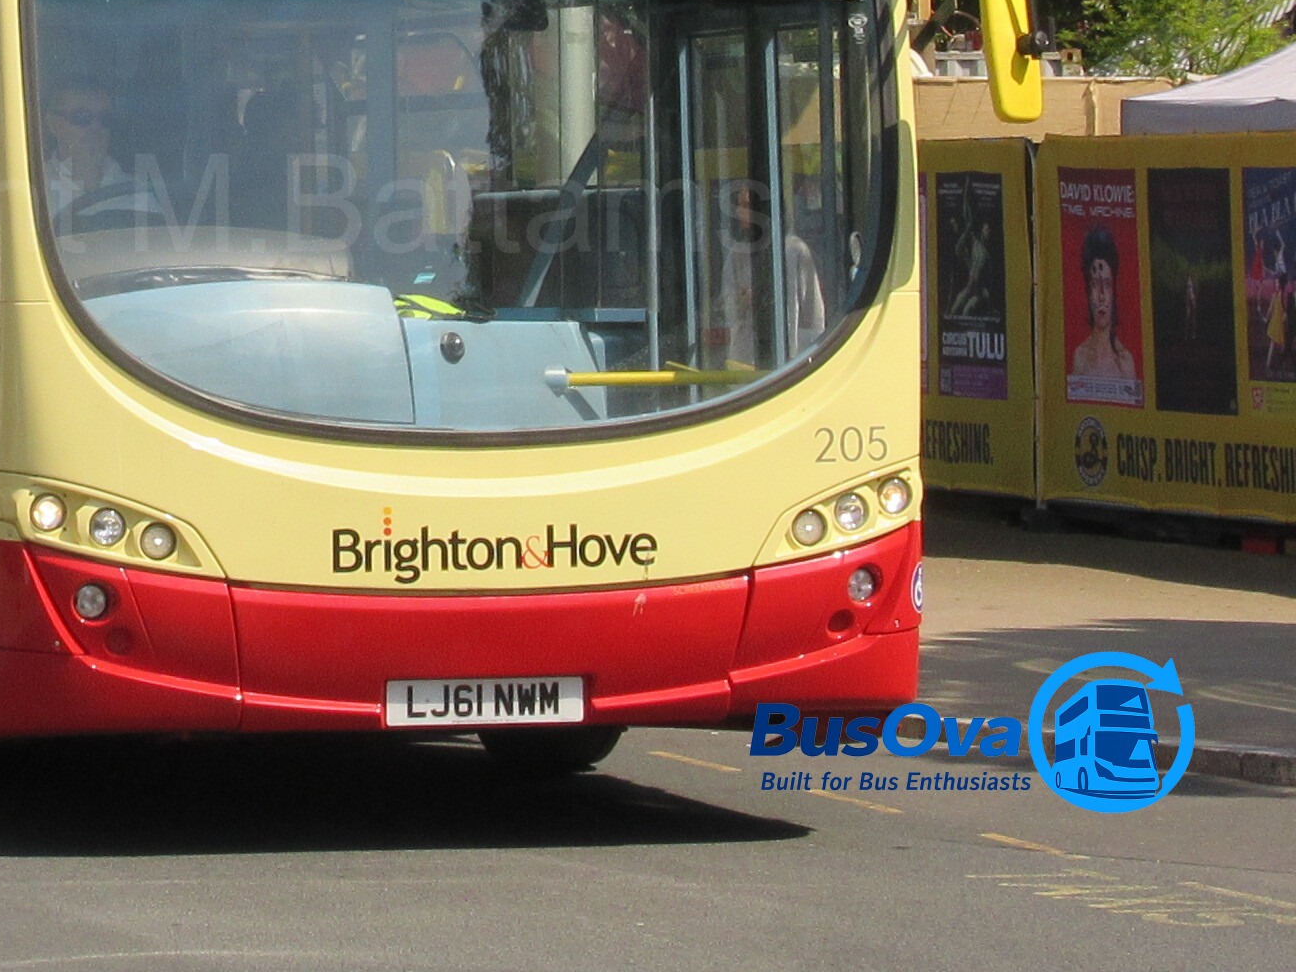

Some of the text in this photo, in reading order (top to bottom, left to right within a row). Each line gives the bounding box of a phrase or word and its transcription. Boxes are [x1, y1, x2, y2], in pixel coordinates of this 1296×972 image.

[1059, 181, 1091, 202] DAVID
[966, 331, 1005, 361] TULU
[814, 425, 888, 464] 205
[1116, 432, 1163, 483] CRISP.
[1164, 437, 1222, 488] BRIGHT.
[1224, 442, 1296, 494] REFRESHI
[406, 681, 560, 719] LJ61 NWM
